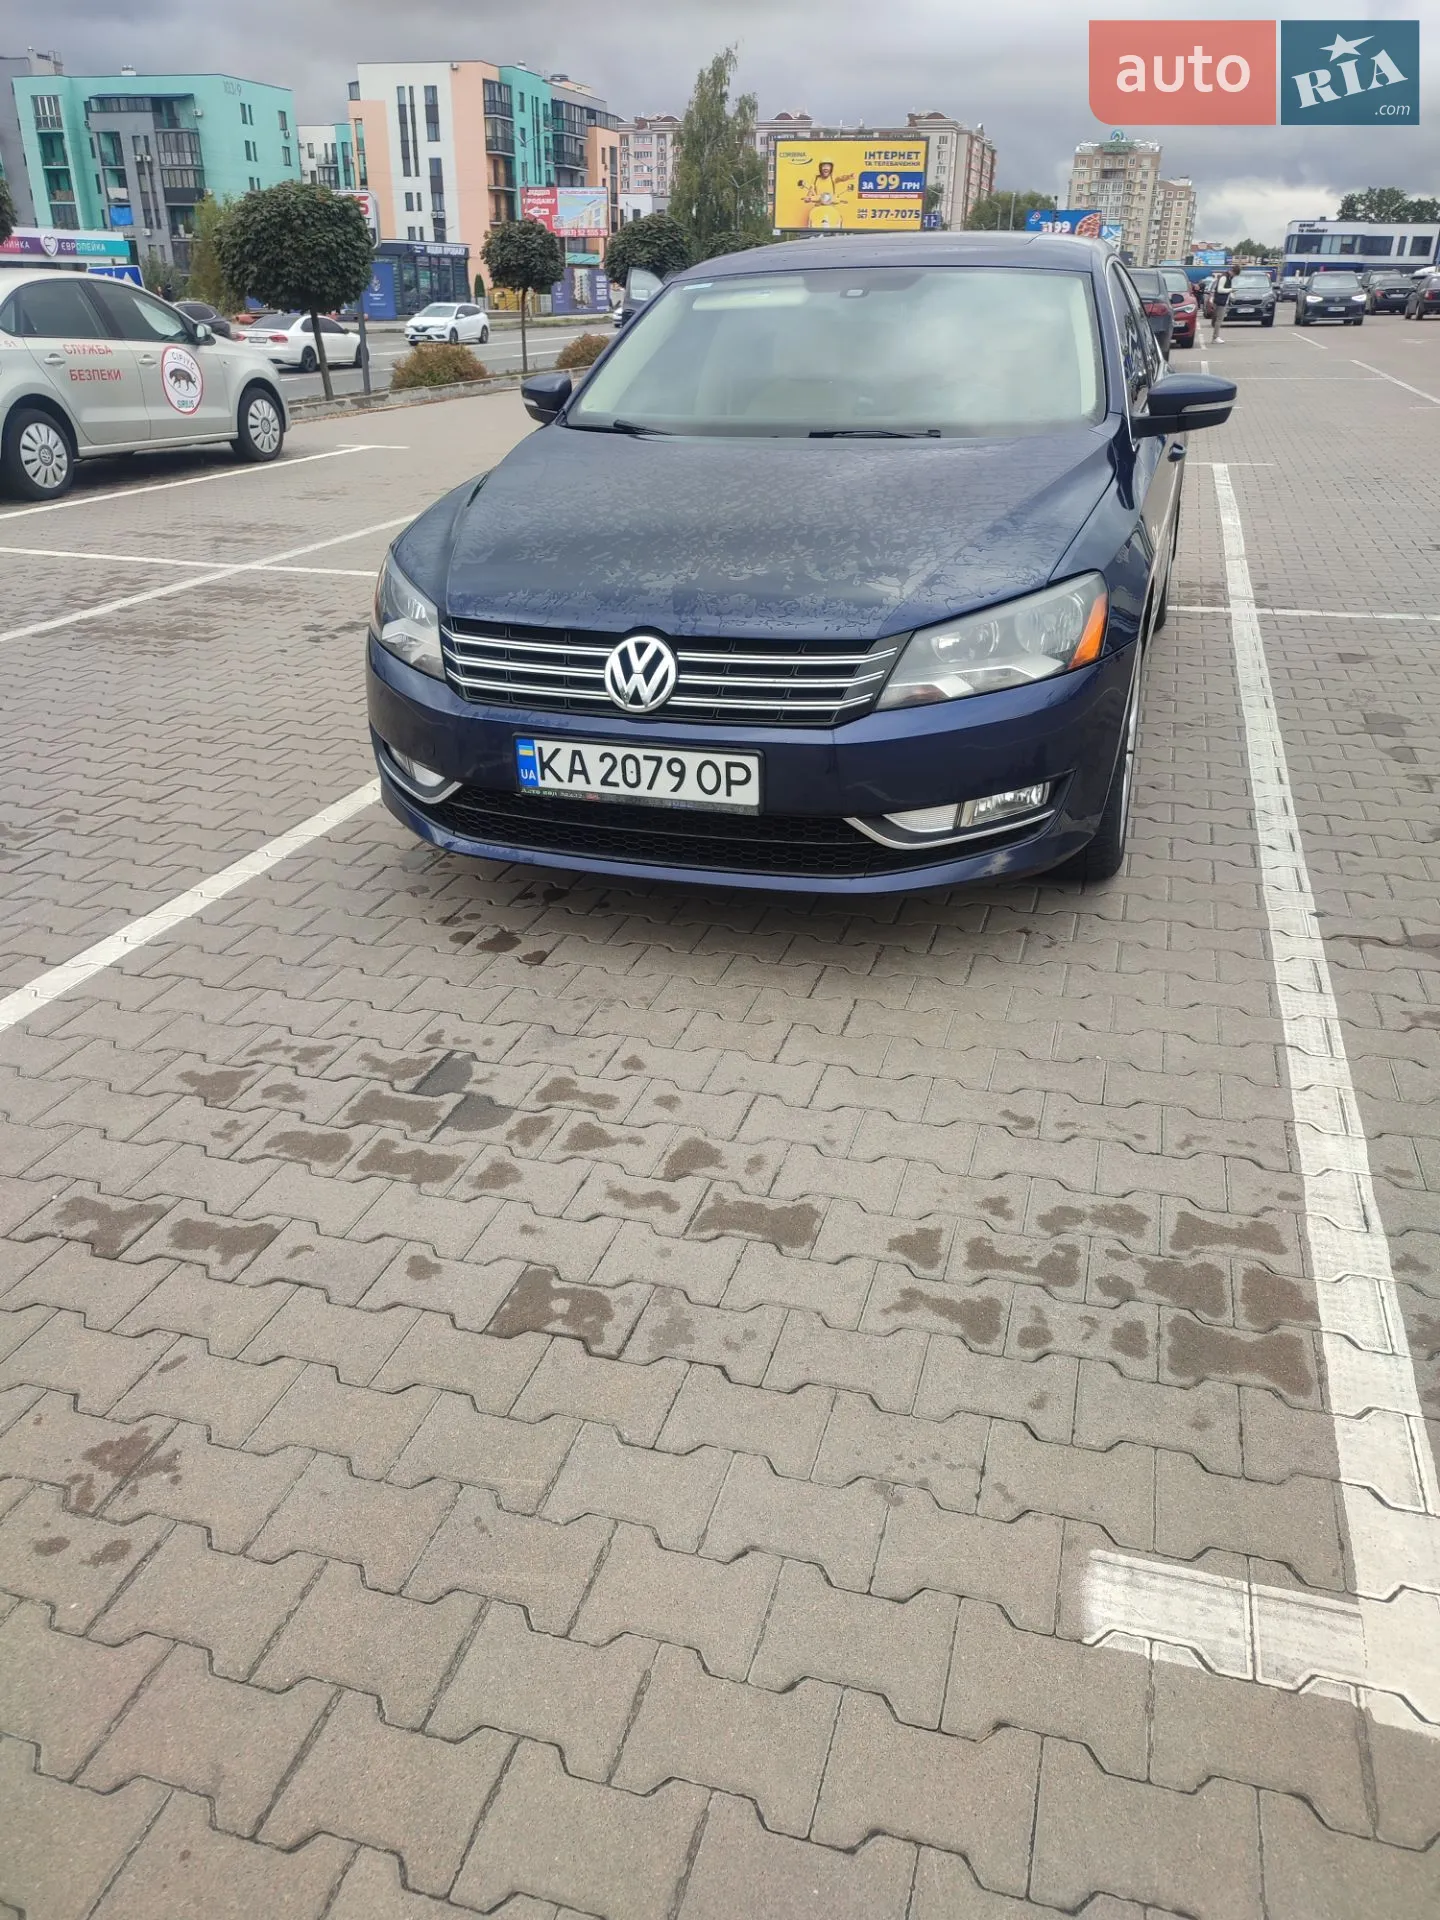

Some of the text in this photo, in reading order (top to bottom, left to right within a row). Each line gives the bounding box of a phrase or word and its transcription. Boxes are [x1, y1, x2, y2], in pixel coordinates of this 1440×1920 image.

[864, 151, 921, 160] ІНТЕРНЕТ
[861, 174, 920, 190] ЗА 99 ГРН
[871, 209, 920, 218] 377-7075
[61, 241, 106, 252] ЄВРОПЕЙКА
[62, 343, 113, 355] СЛУЖБА
[69, 368, 122, 381] БЕЗПЕКИ
[520, 768, 537, 780] UA
[537, 746, 752, 797] KA 2079 OP
